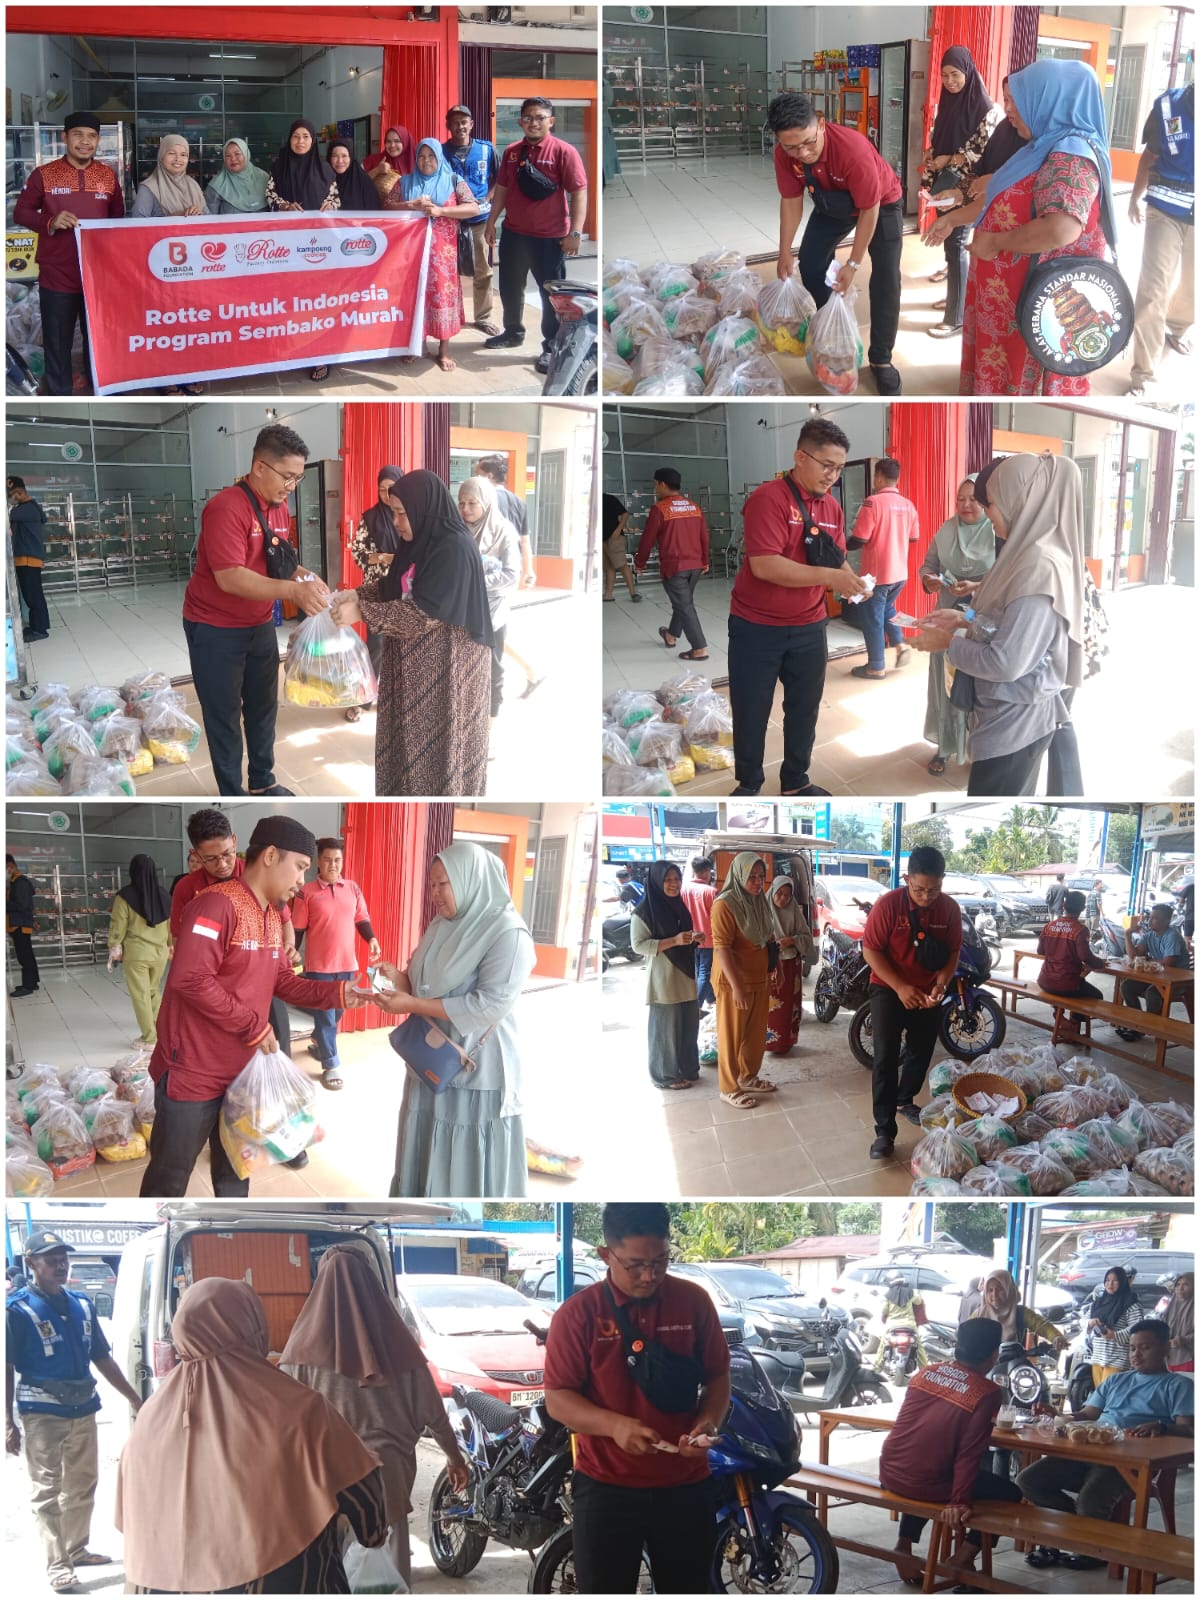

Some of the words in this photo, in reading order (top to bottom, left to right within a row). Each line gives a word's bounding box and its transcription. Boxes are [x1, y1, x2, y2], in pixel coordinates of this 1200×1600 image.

[247, 239, 291, 260] Rotte
[345, 238, 372, 250] rotte
[163, 265, 193, 274] BABADA
[201, 264, 226, 273] rotte
[1043, 272, 1087, 295] STANDAR
[1087, 273, 1121, 309] NASIONAL
[145, 307, 211, 326] Rotte
[218, 297, 287, 320] Untuk
[293, 283, 389, 313] Indonesia
[1031, 295, 1047, 334] REBANA
[129, 328, 232, 352] Program
[239, 314, 335, 341] Sembako
[341, 306, 404, 328] Murah
[1035, 334, 1054, 356] ALAT
[54, 1228, 104, 1244] USTIK@
